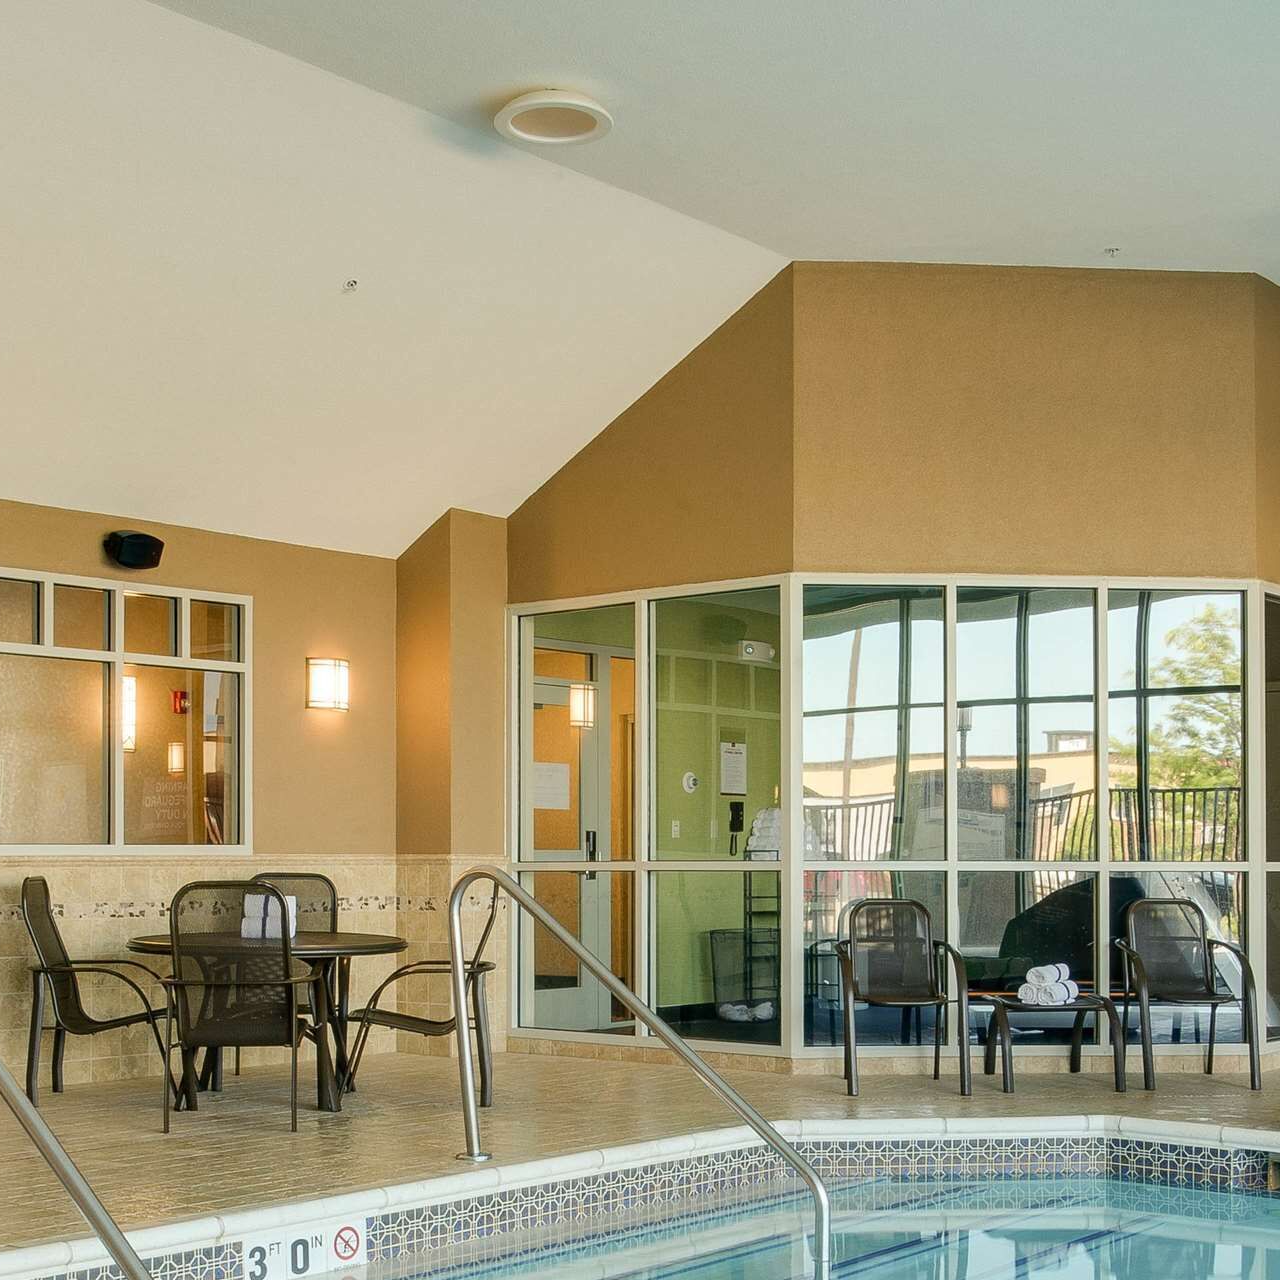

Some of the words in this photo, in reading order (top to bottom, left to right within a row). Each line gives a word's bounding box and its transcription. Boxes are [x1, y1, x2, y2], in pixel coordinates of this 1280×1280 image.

[269, 1242, 282, 1257] FT
[290, 1238, 310, 1275] 0
[311, 1234, 323, 1249] IN
